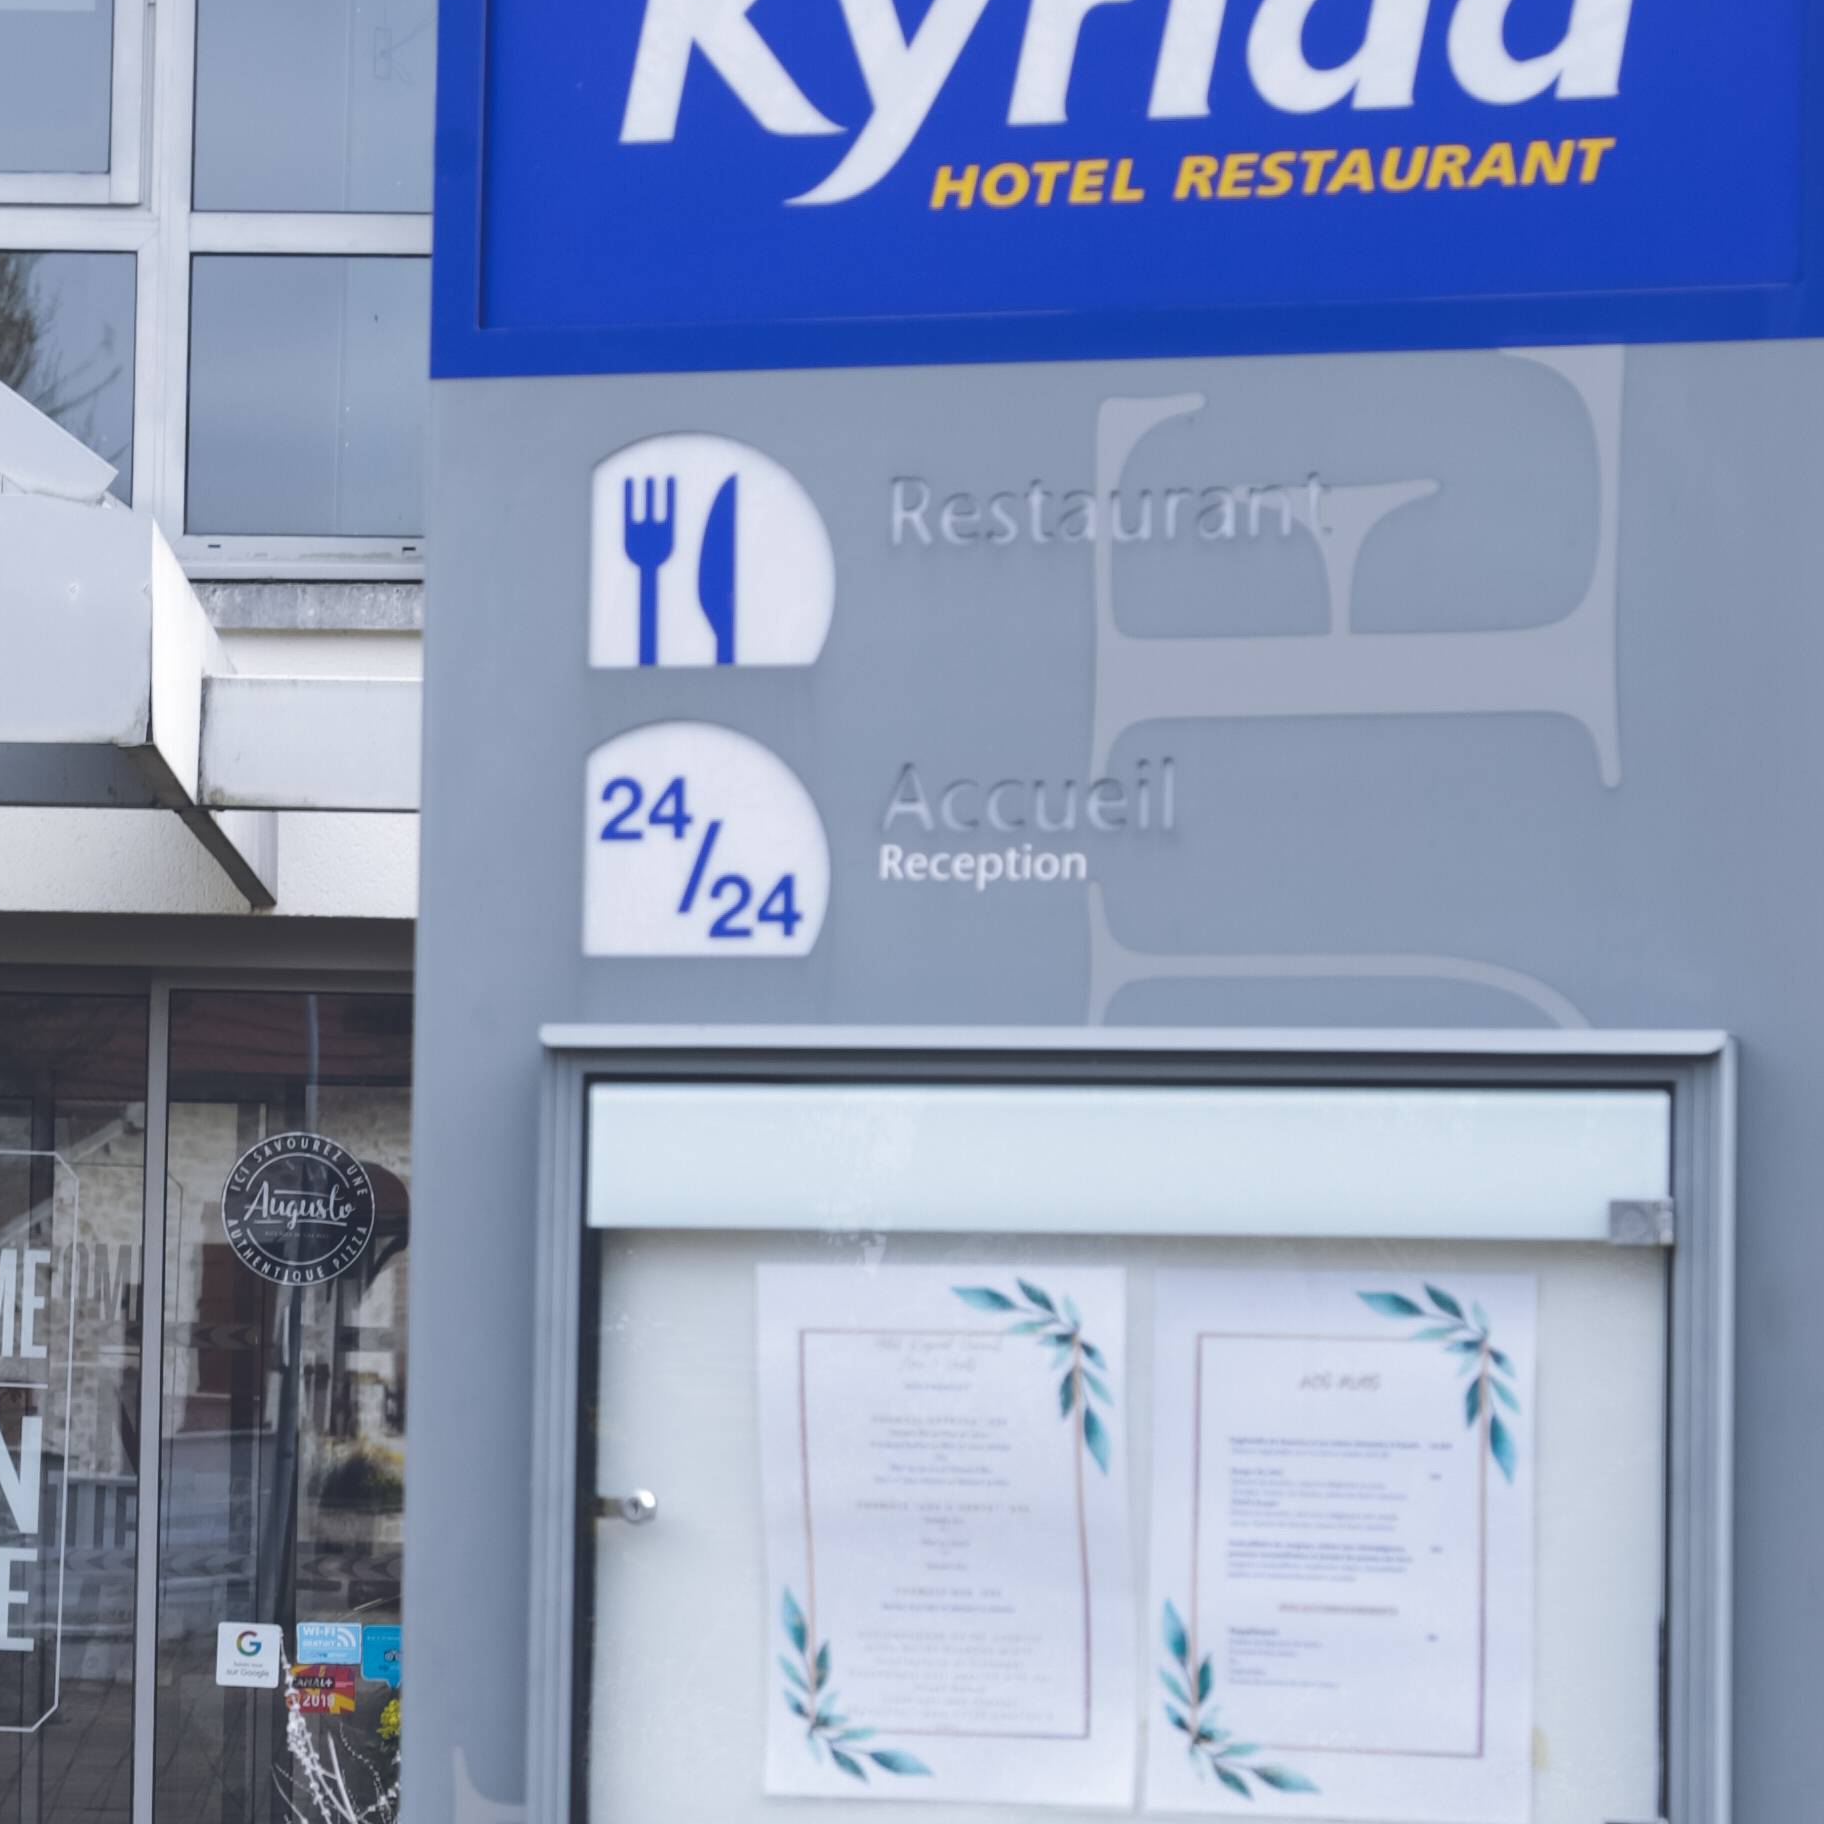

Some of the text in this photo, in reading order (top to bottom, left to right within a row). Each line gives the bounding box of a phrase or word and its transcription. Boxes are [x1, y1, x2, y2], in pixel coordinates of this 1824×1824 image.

[929, 137, 1616, 209] HOTEL RESTAURANT
[890, 471, 1333, 547] Restaurant
[883, 755, 1176, 832] Accueil
[879, 843, 1087, 891] Reception
[230, 1136, 368, 1196] ICI SAVOUREZ UNE
[243, 1180, 355, 1230] Augusto
[227, 1218, 368, 1284] AUTHENTIQUE PIZZA
